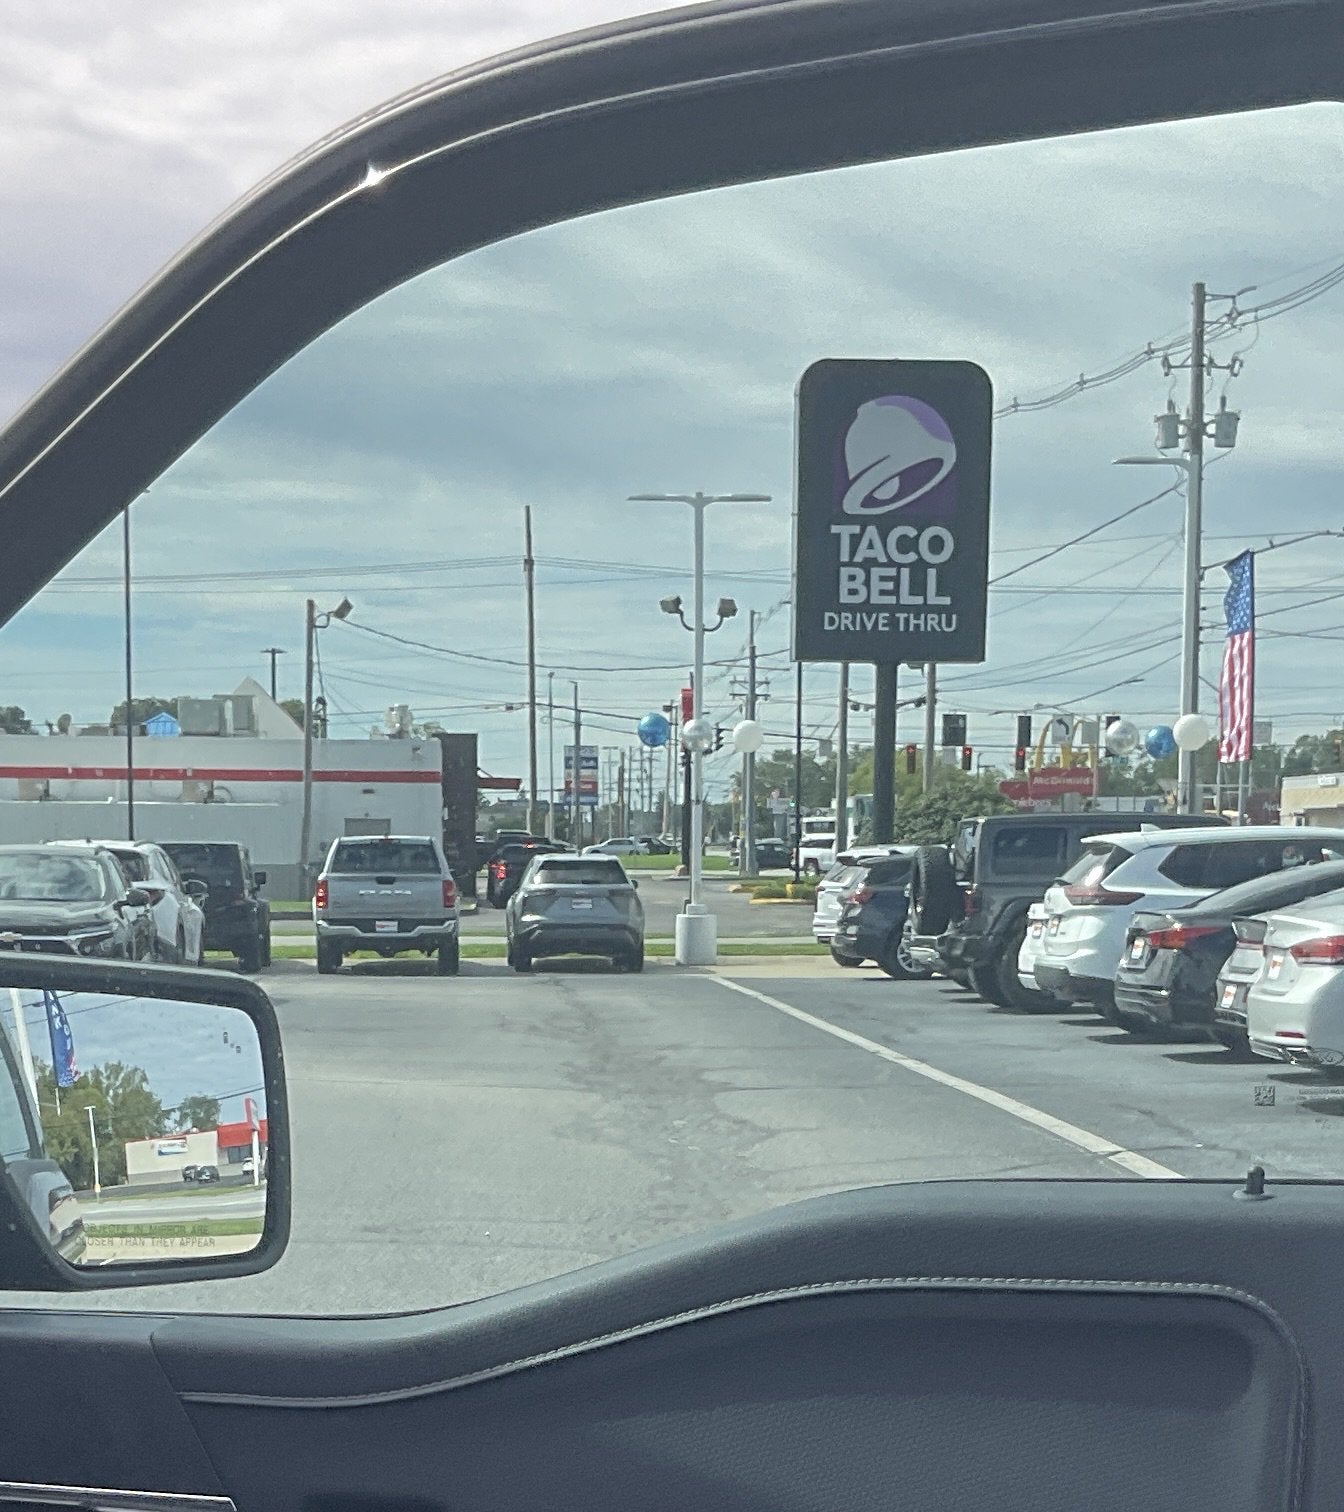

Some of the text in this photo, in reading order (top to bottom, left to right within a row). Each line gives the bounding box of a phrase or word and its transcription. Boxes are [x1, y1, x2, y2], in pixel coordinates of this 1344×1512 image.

[830, 524, 955, 564] TACO
[838, 566, 952, 605] BELL
[823, 612, 957, 632] DRIVE THRU
[120, 1236, 145, 1247] THAN
[151, 1236, 175, 1247] THEY
[179, 1236, 216, 1248] APPEAR
